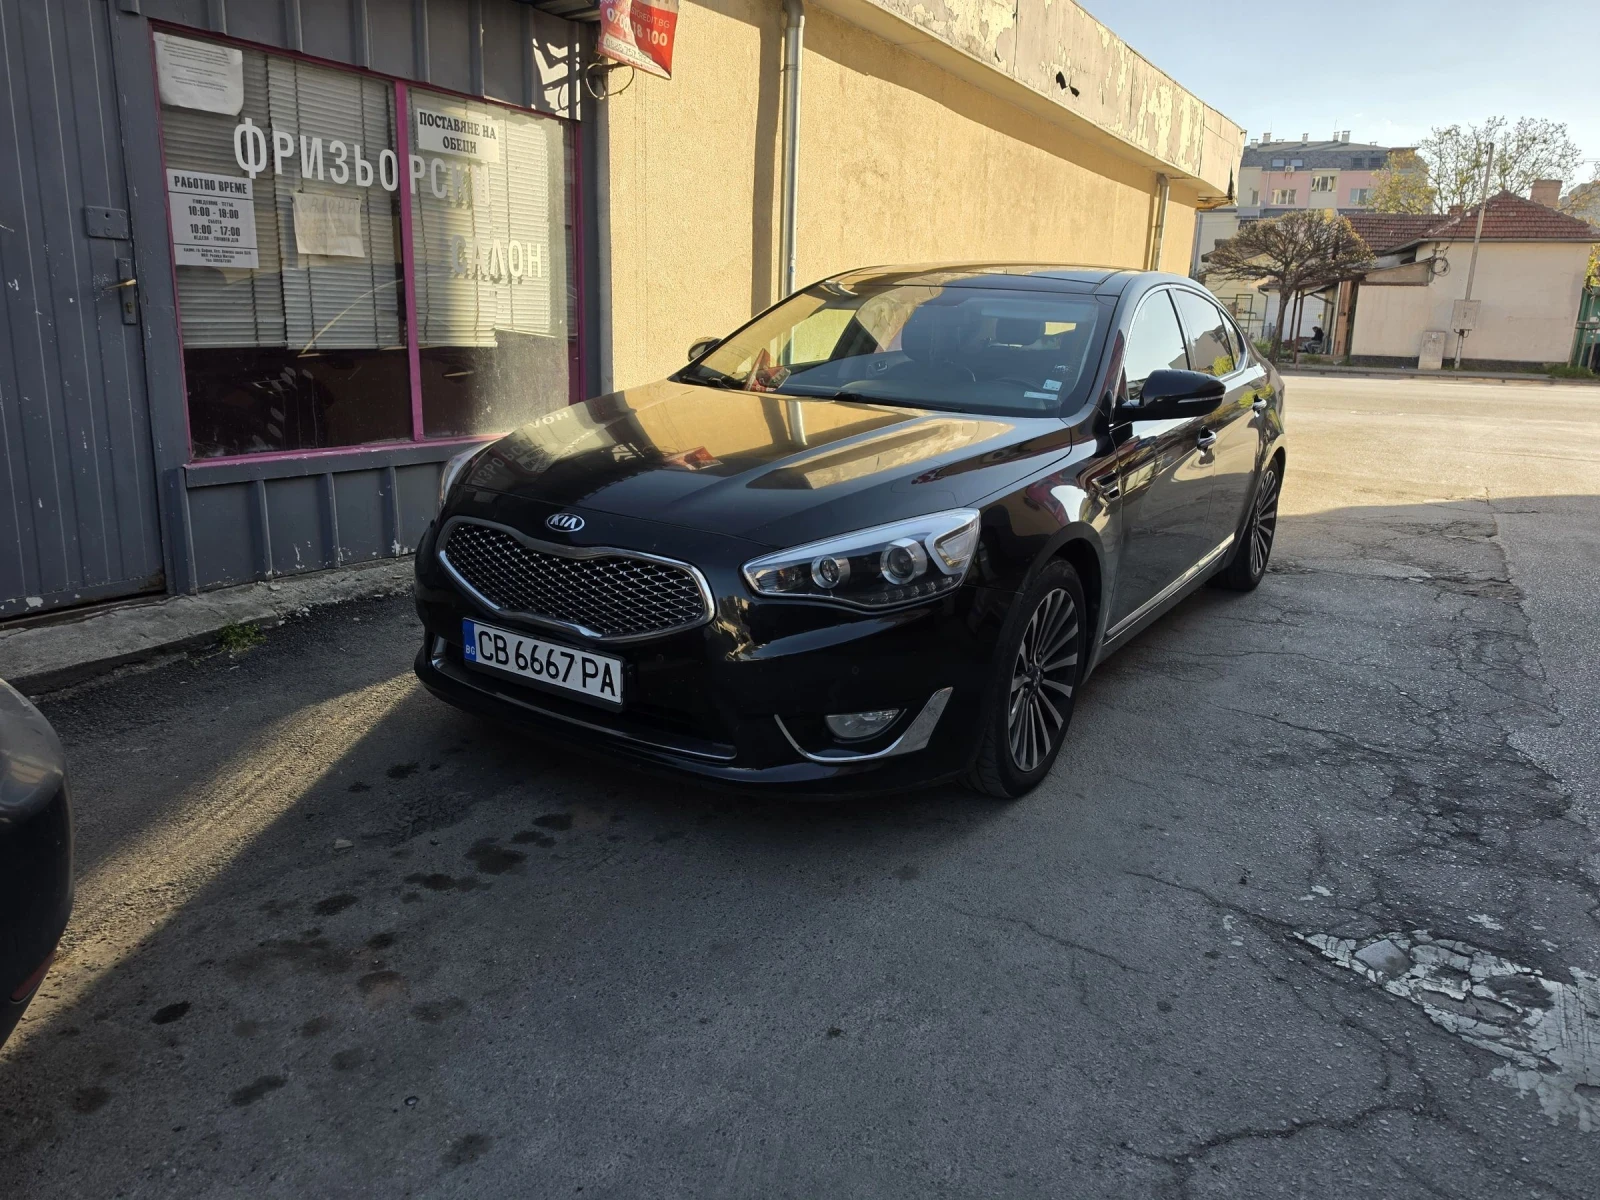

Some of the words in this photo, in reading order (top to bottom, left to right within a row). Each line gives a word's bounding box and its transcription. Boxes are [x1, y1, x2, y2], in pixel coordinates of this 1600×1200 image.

[646, 28, 668, 47] 100
[419, 112, 480, 137] ПОСТАВЯНЕ
[482, 125, 497, 140] НА
[442, 136, 478, 154] ОБЕЦИ
[233, 118, 490, 205] ФРИЗЬОРСКИ
[174, 176, 216, 191] РАБОТНО
[218, 181, 247, 194] ВРЕМЕ
[188, 206, 210, 217] 10:00
[190, 224, 212, 235] 10:00
[220, 226, 240, 237] 17:00
[451, 234, 542, 278] САЛОН
[550, 514, 576, 529] KIA
[465, 644, 476, 656] BG
[514, 640, 576, 683] 6667
